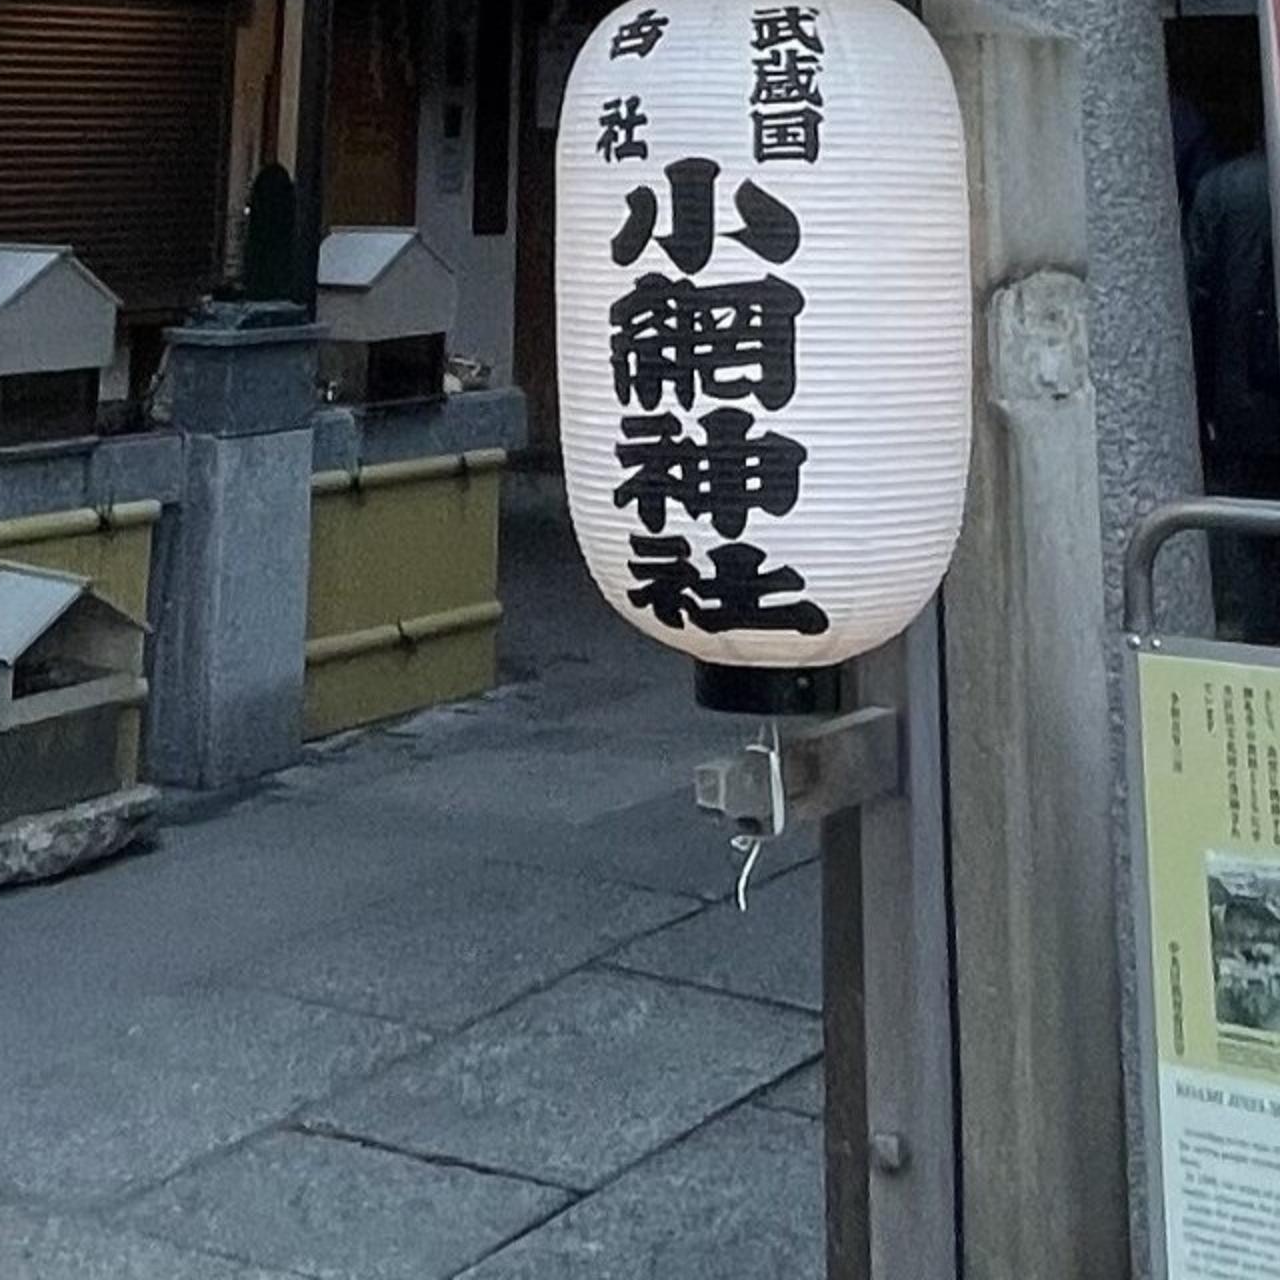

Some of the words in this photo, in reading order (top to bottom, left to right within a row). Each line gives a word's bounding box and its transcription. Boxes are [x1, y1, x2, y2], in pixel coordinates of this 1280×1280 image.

[749, 6, 824, 164] 武蔵国
[609, 157, 829, 634] 小網神社
